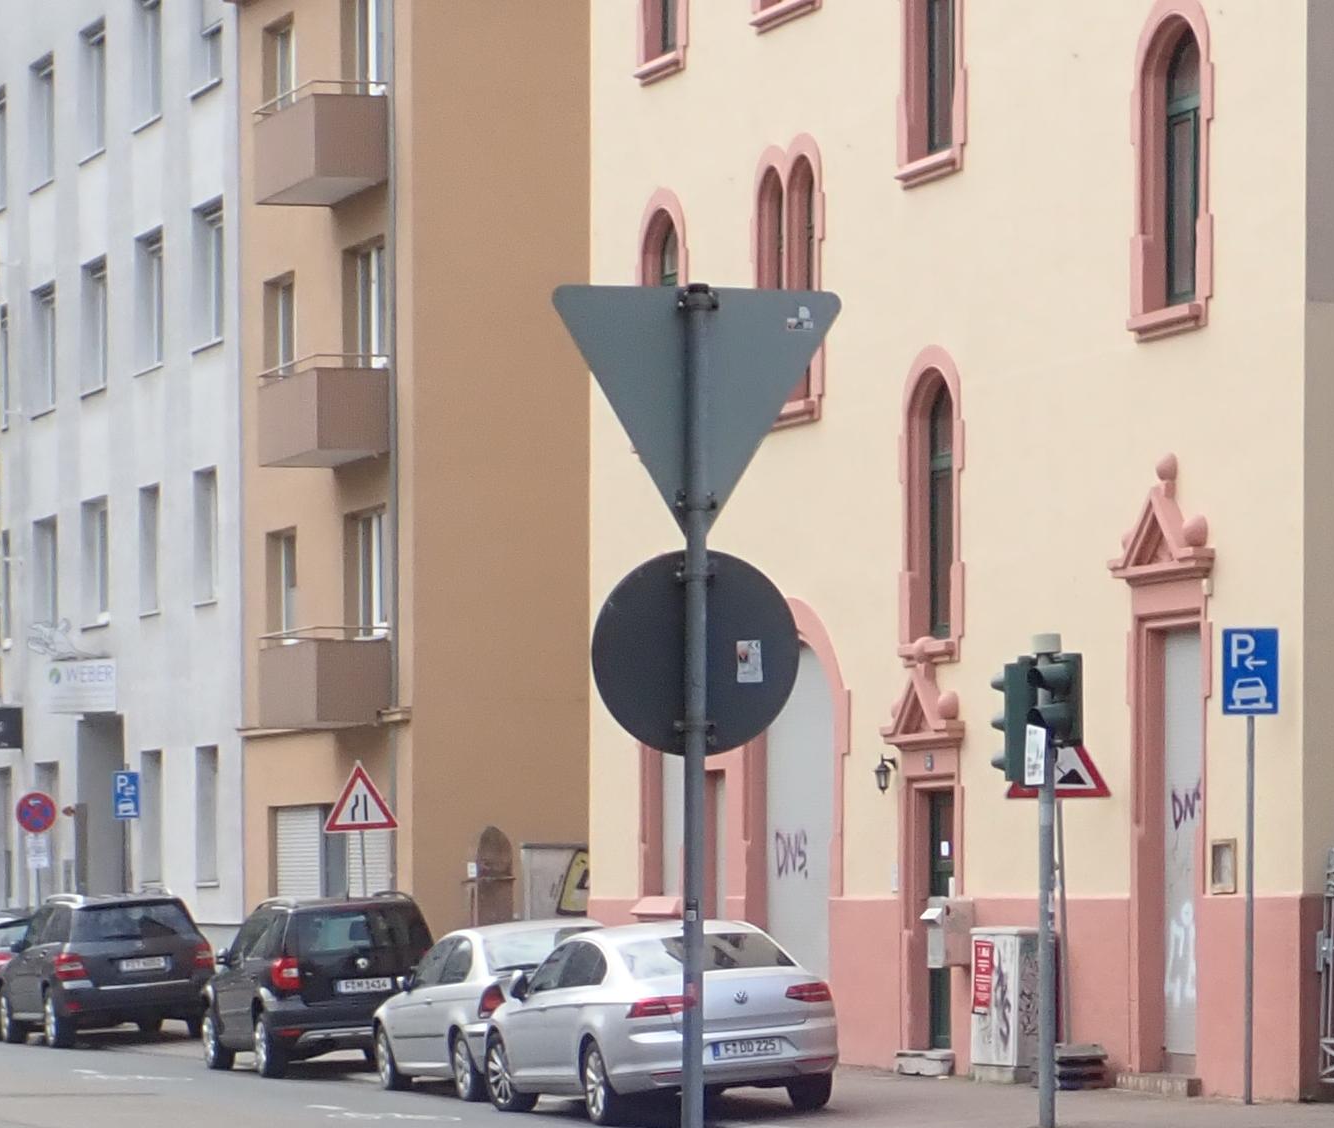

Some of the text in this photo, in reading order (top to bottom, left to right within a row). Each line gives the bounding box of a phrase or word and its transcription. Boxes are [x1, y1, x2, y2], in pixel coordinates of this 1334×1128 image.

[1231, 633, 1256, 668] P
[67, 665, 114, 683] WEBER
[116, 774, 129, 794] P
[739, 1040, 754, 1053] DD
[756, 1040, 776, 1052] 225
